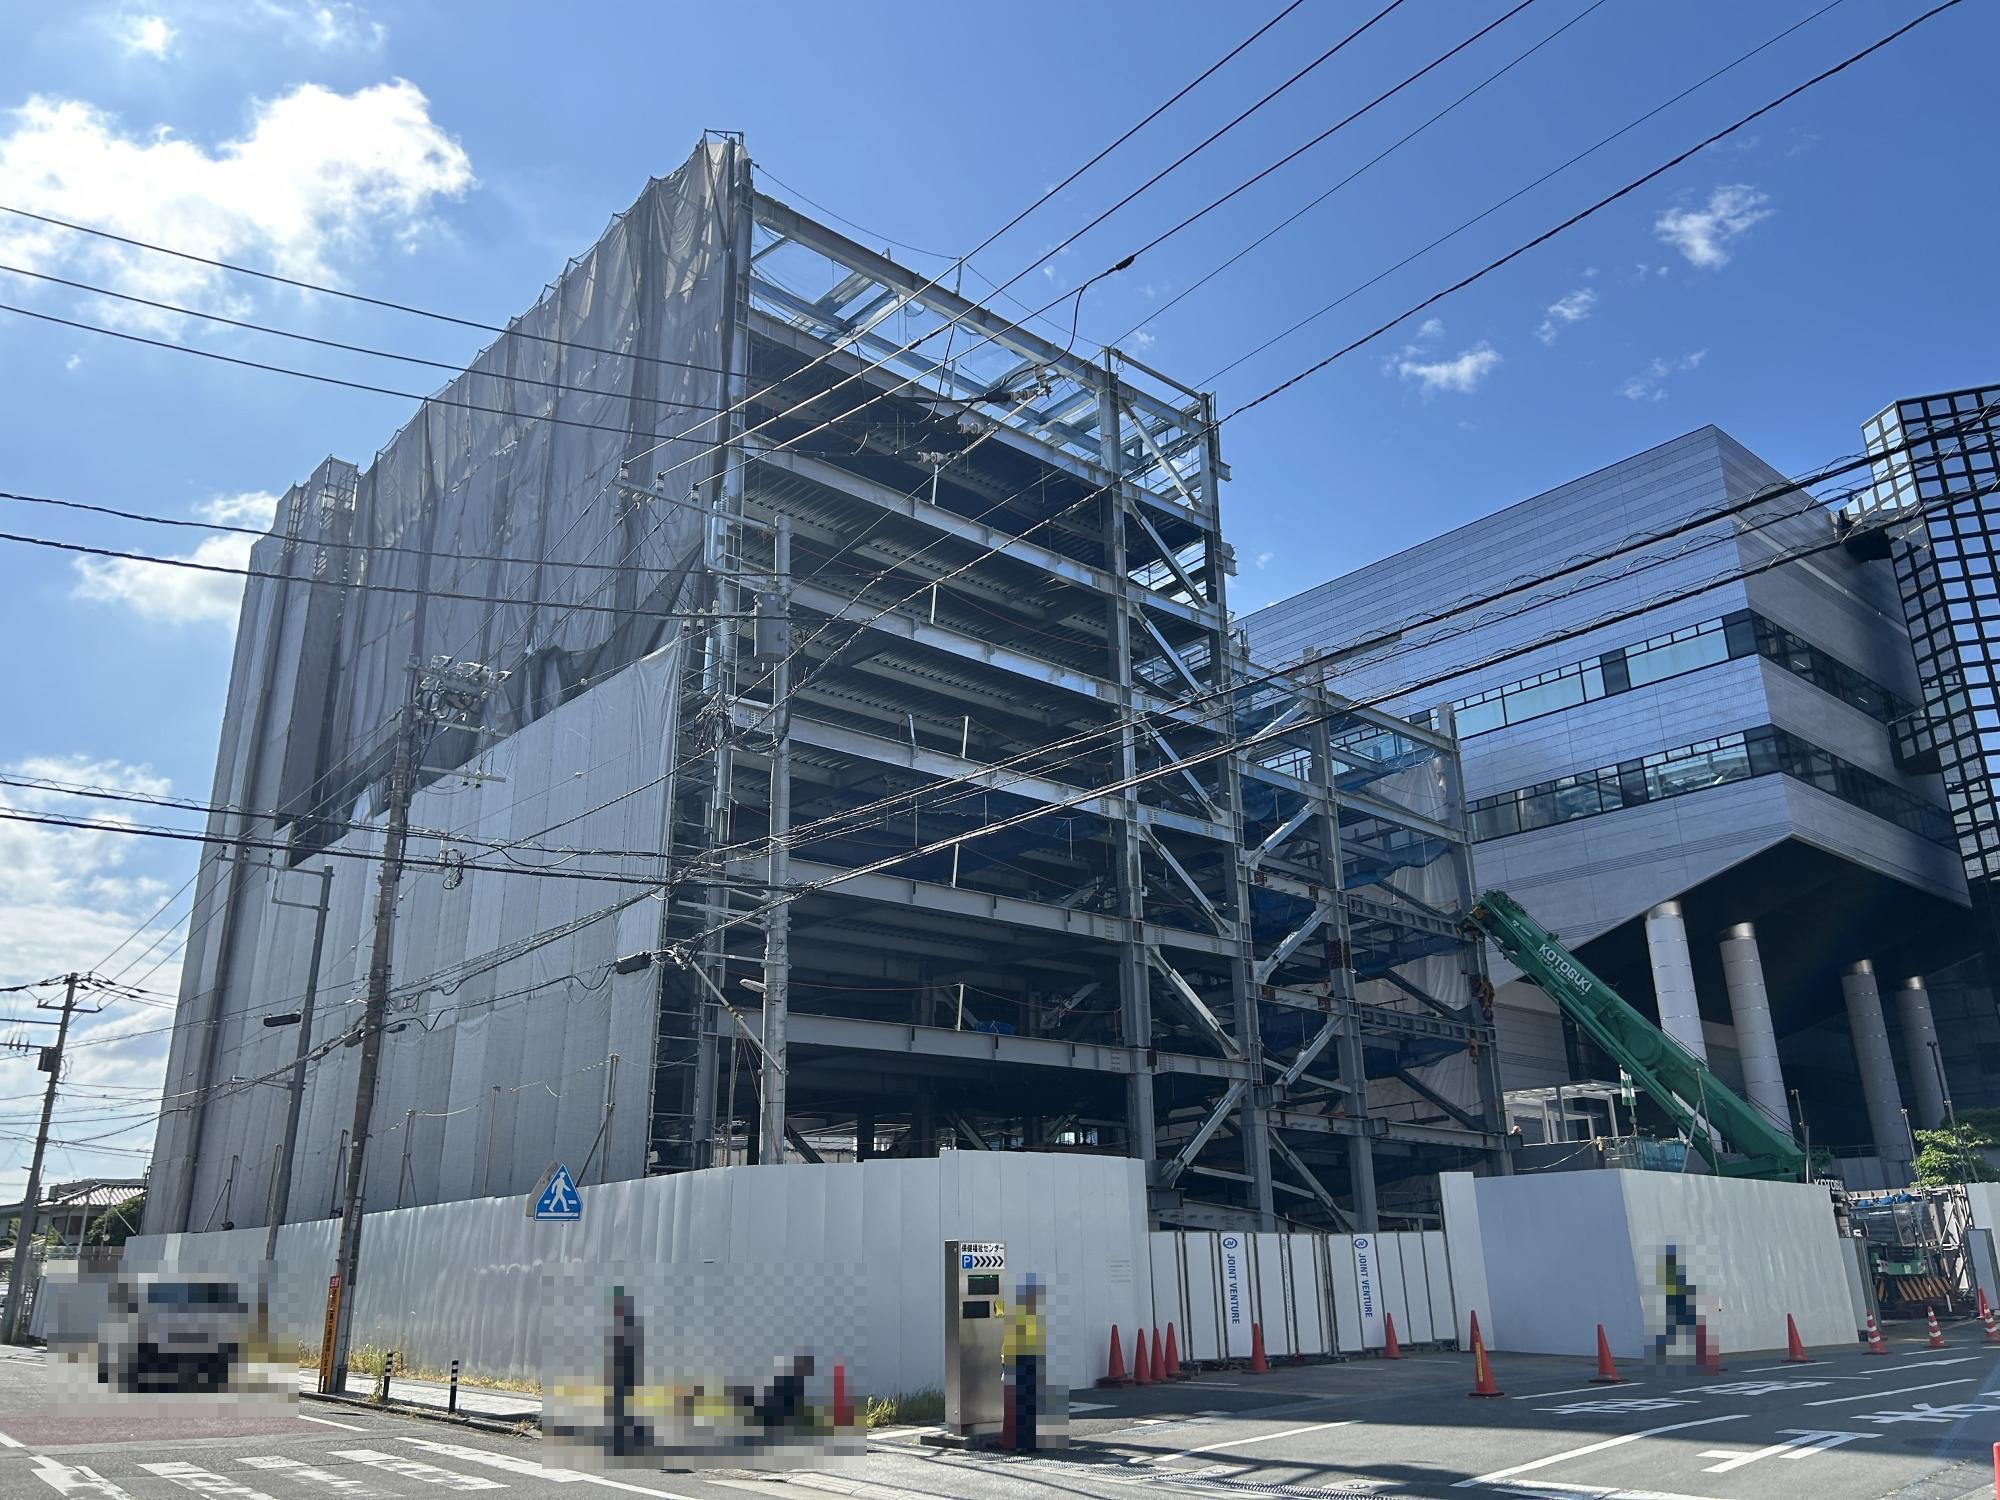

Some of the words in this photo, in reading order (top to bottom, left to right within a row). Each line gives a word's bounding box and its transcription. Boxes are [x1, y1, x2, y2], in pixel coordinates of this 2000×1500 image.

[963, 1256, 971, 1268] P
[1227, 1253, 1237, 1280] JOINT
[1358, 1252, 1368, 1277] JOINT
[1229, 1282, 1240, 1325] VENTURE
[1361, 1280, 1373, 1318] VENTURE
